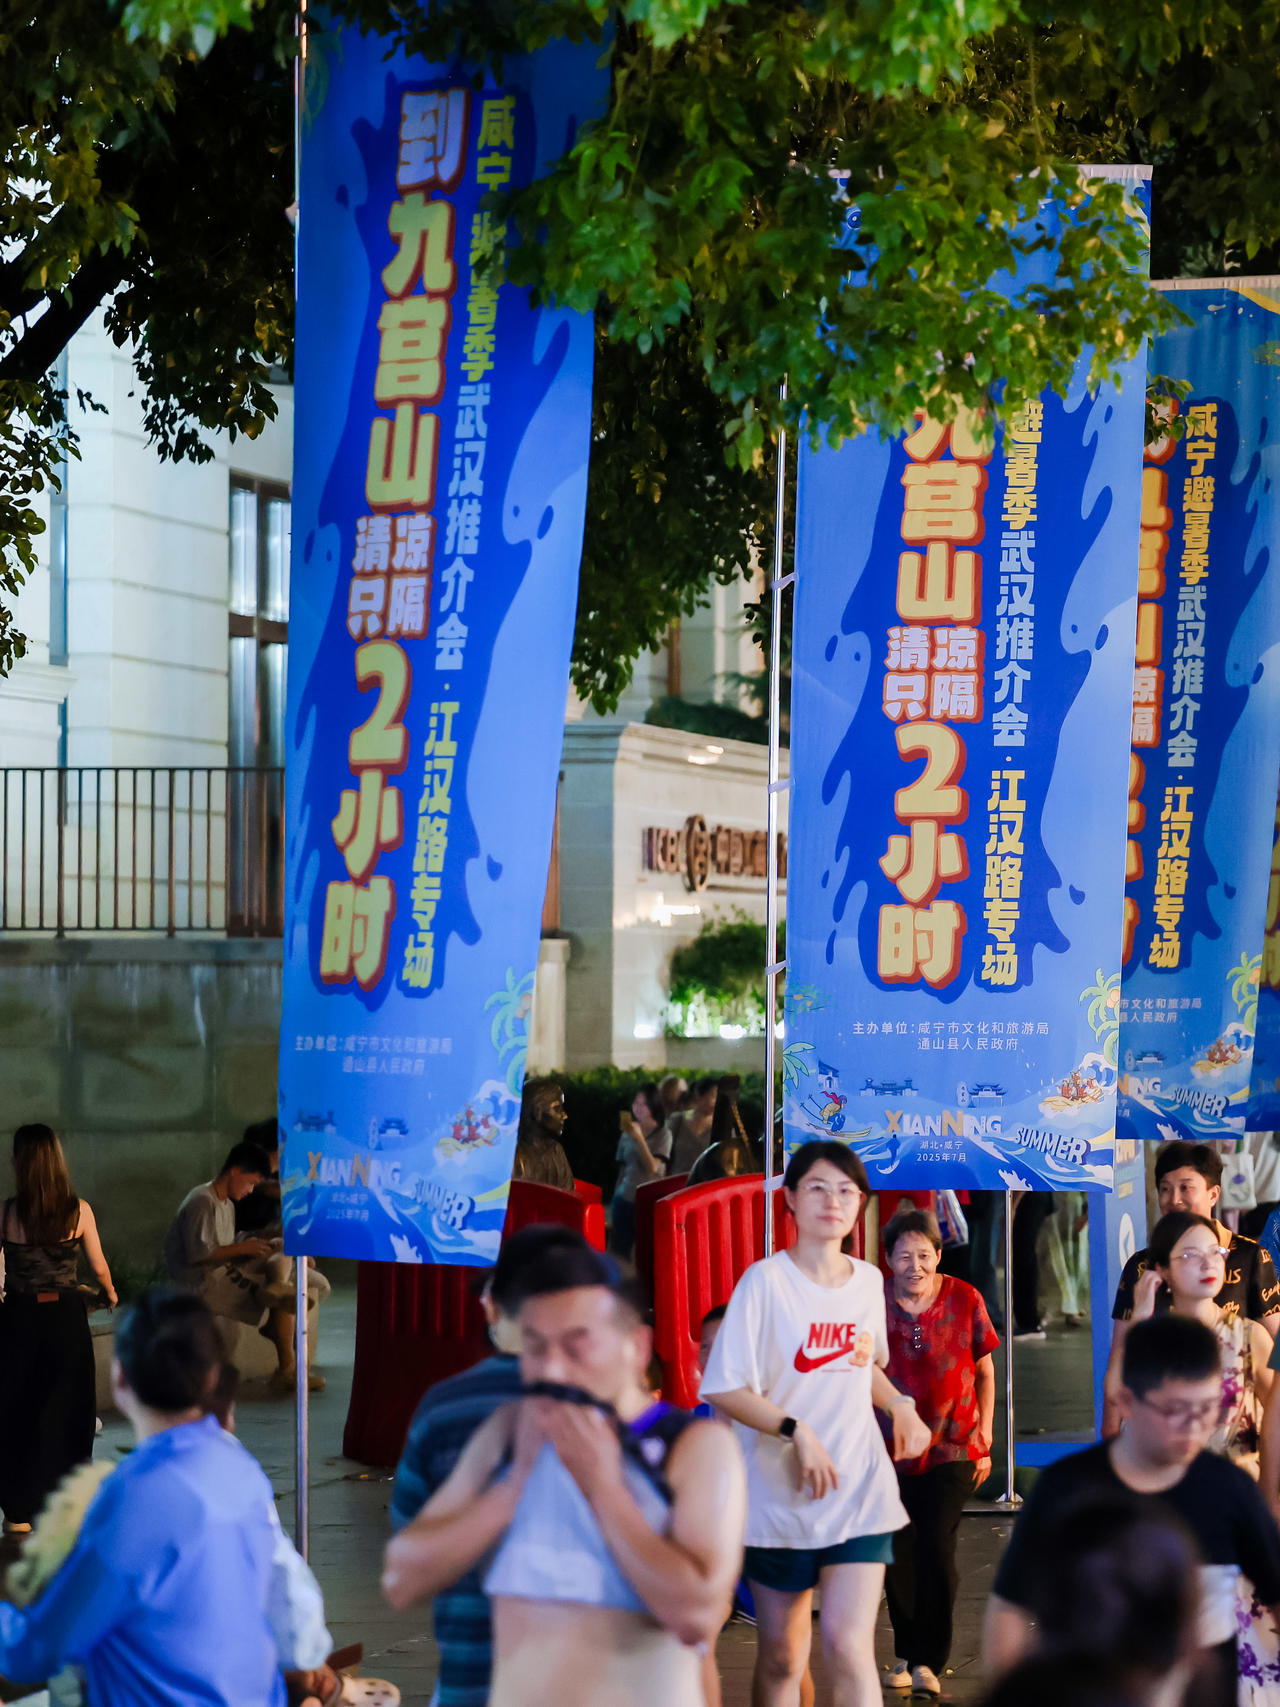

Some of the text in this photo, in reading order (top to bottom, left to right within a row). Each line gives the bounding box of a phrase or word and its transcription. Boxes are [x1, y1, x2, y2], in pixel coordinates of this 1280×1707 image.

[884, 626, 979, 672] 清凉
[882, 674, 980, 720] 只隔
[877, 720, 966, 988] 2小时
[918, 1037, 1019, 1051] 通山县人民政府
[1172, 1087, 1229, 1118] SUMMER
[884, 1109, 1002, 1137] XIANNING
[916, 1153, 966, 1163] 2025年7月
[1015, 1126, 1090, 1166] SUMMER
[306, 1151, 401, 1188] XIANNING
[411, 1177, 475, 1231] SUMMER
[807, 1322, 856, 1349] NIKE
